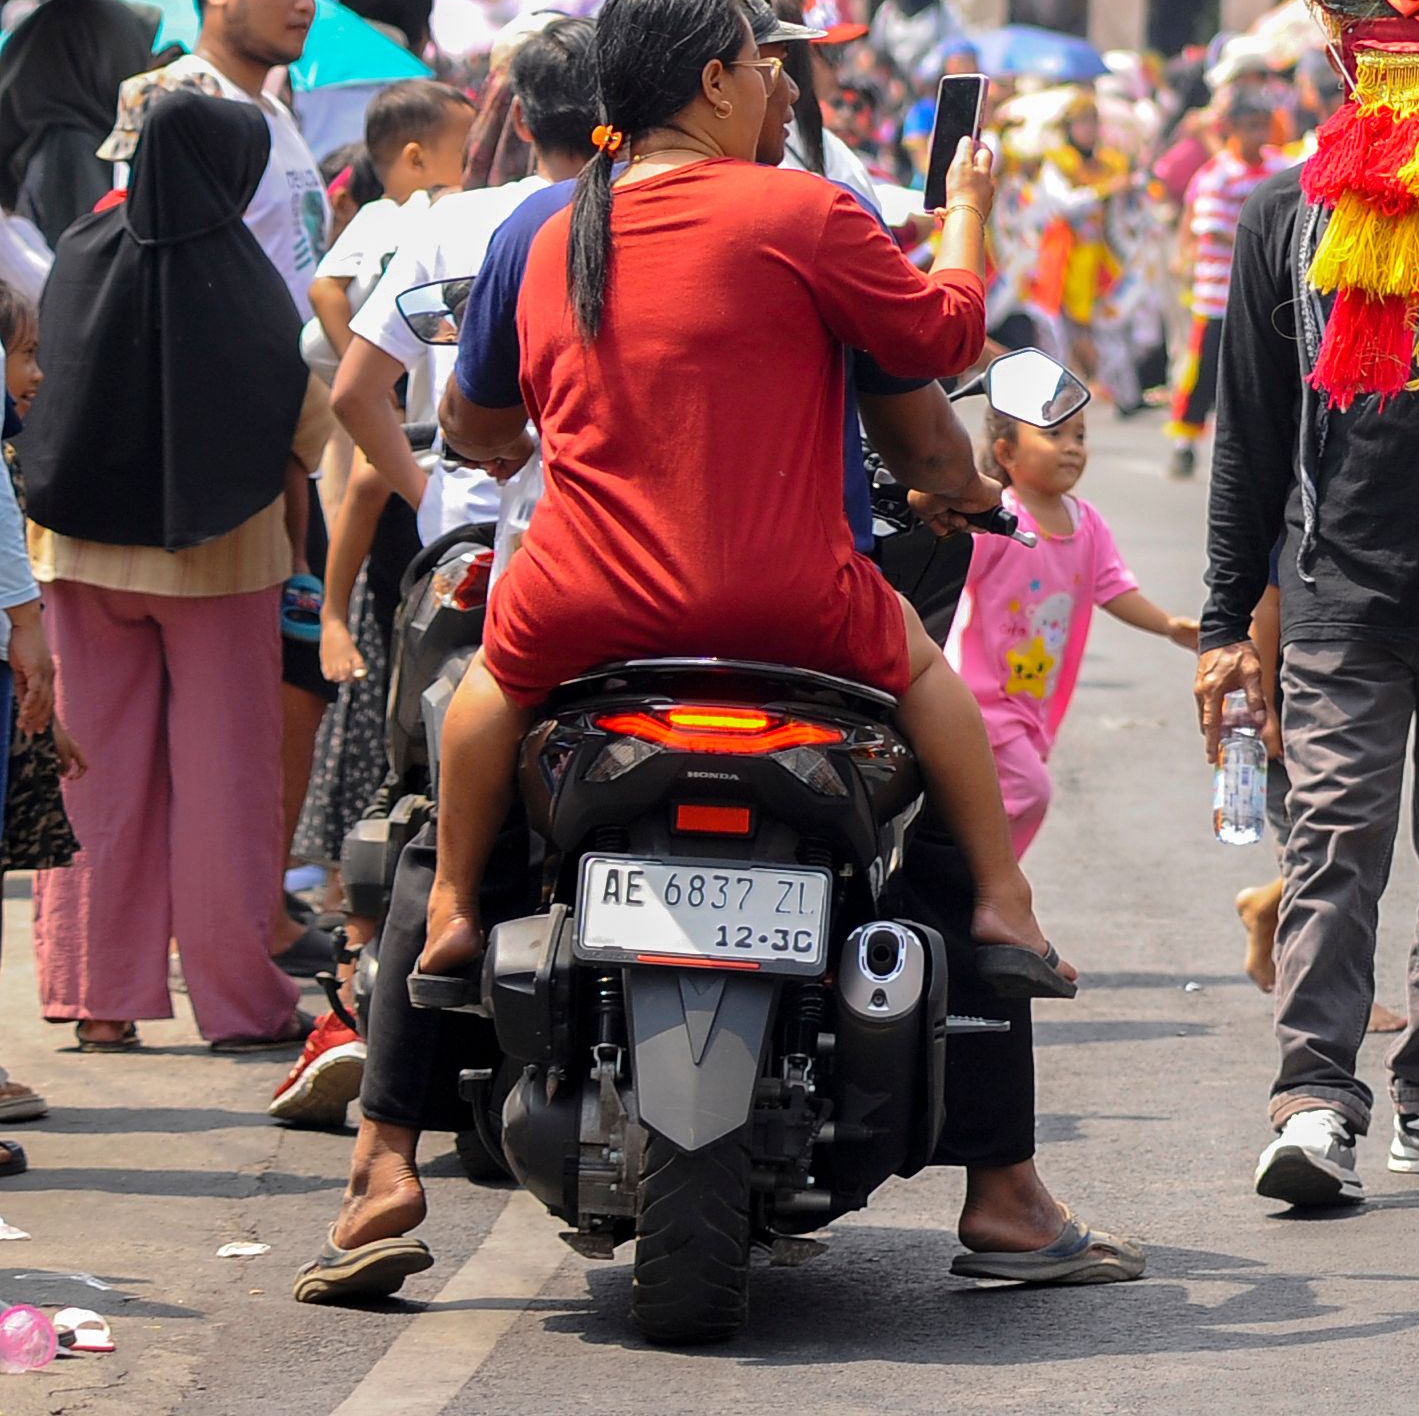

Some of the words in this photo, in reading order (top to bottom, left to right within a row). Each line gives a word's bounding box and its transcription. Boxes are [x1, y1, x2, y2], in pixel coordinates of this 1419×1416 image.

[687, 771, 740, 781] HONDA
[602, 868, 644, 906] AE
[664, 873, 754, 911] 6837
